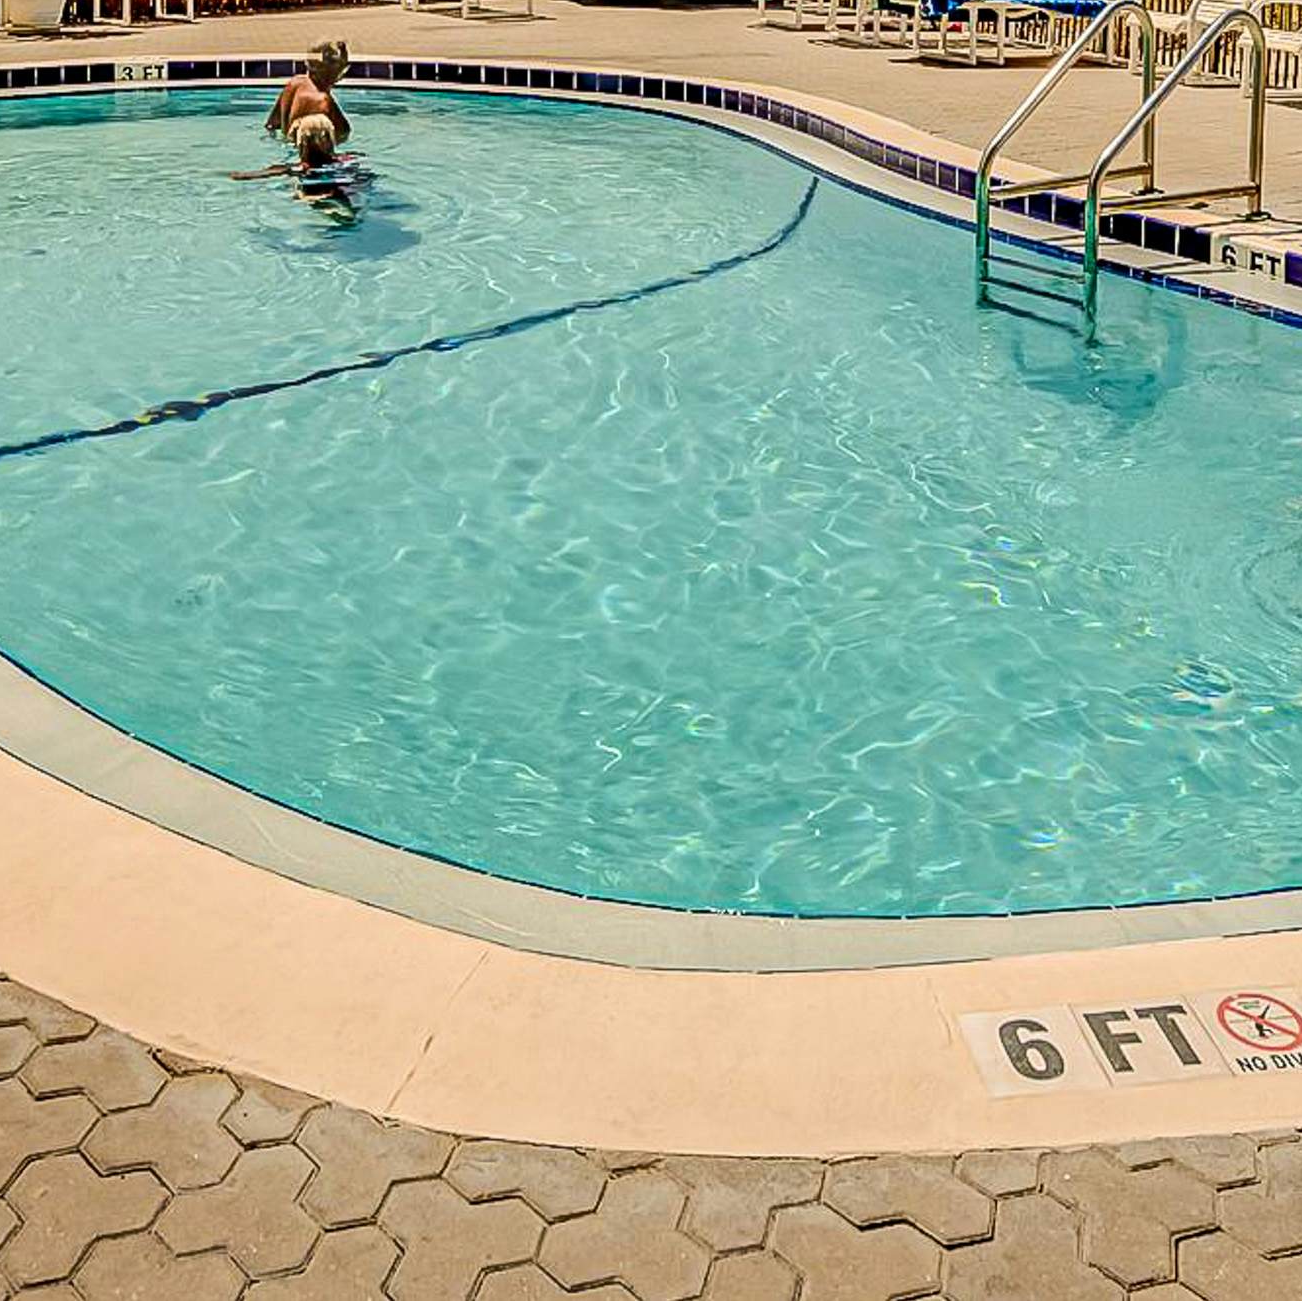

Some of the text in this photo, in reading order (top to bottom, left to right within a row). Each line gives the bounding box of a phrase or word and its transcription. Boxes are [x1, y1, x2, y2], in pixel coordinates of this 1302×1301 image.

[122, 64, 165, 81] 3 FT
[1249, 250, 1282, 277] FT
[998, 1004, 1203, 1081] 6 FT
[1235, 1055, 1268, 1073] NO
